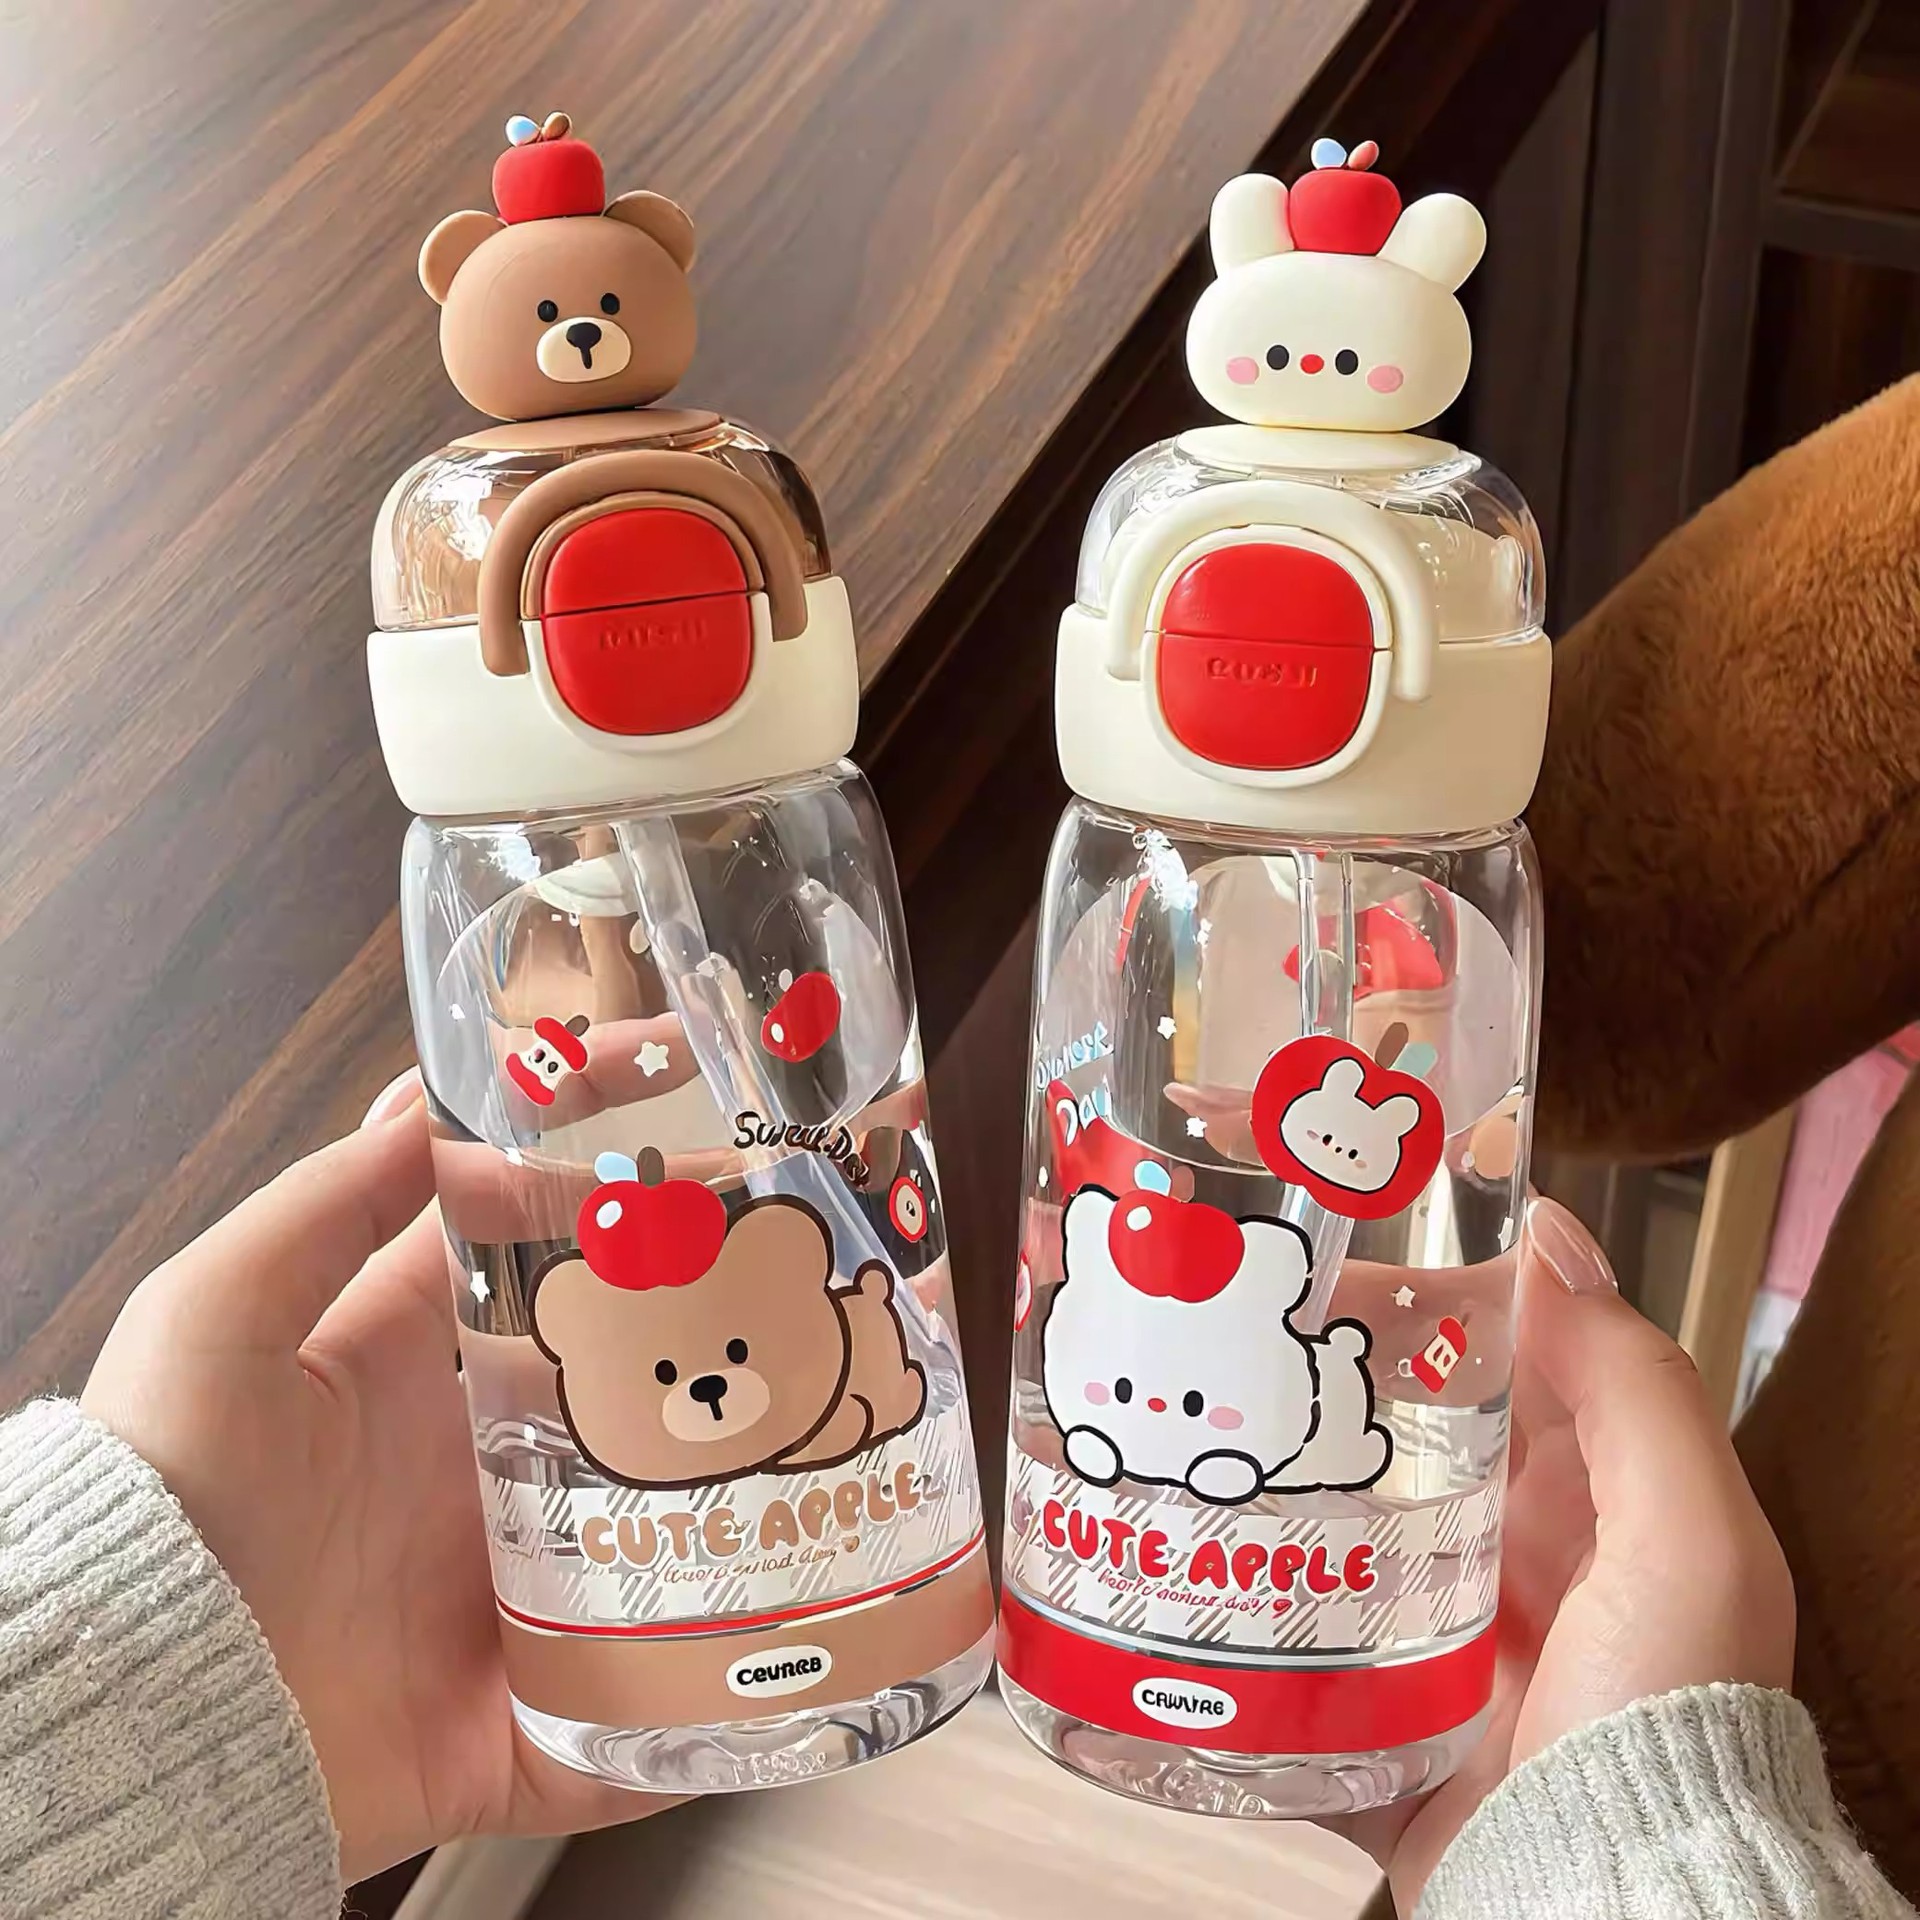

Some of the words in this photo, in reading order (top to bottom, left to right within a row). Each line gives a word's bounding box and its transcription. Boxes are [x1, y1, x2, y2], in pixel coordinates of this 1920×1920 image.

[582, 1507, 743, 1565] CUTE
[759, 1462, 920, 1550] APPLE
[1043, 1499, 1169, 1577] CUTE
[1189, 1540, 1375, 1594] APPLE
